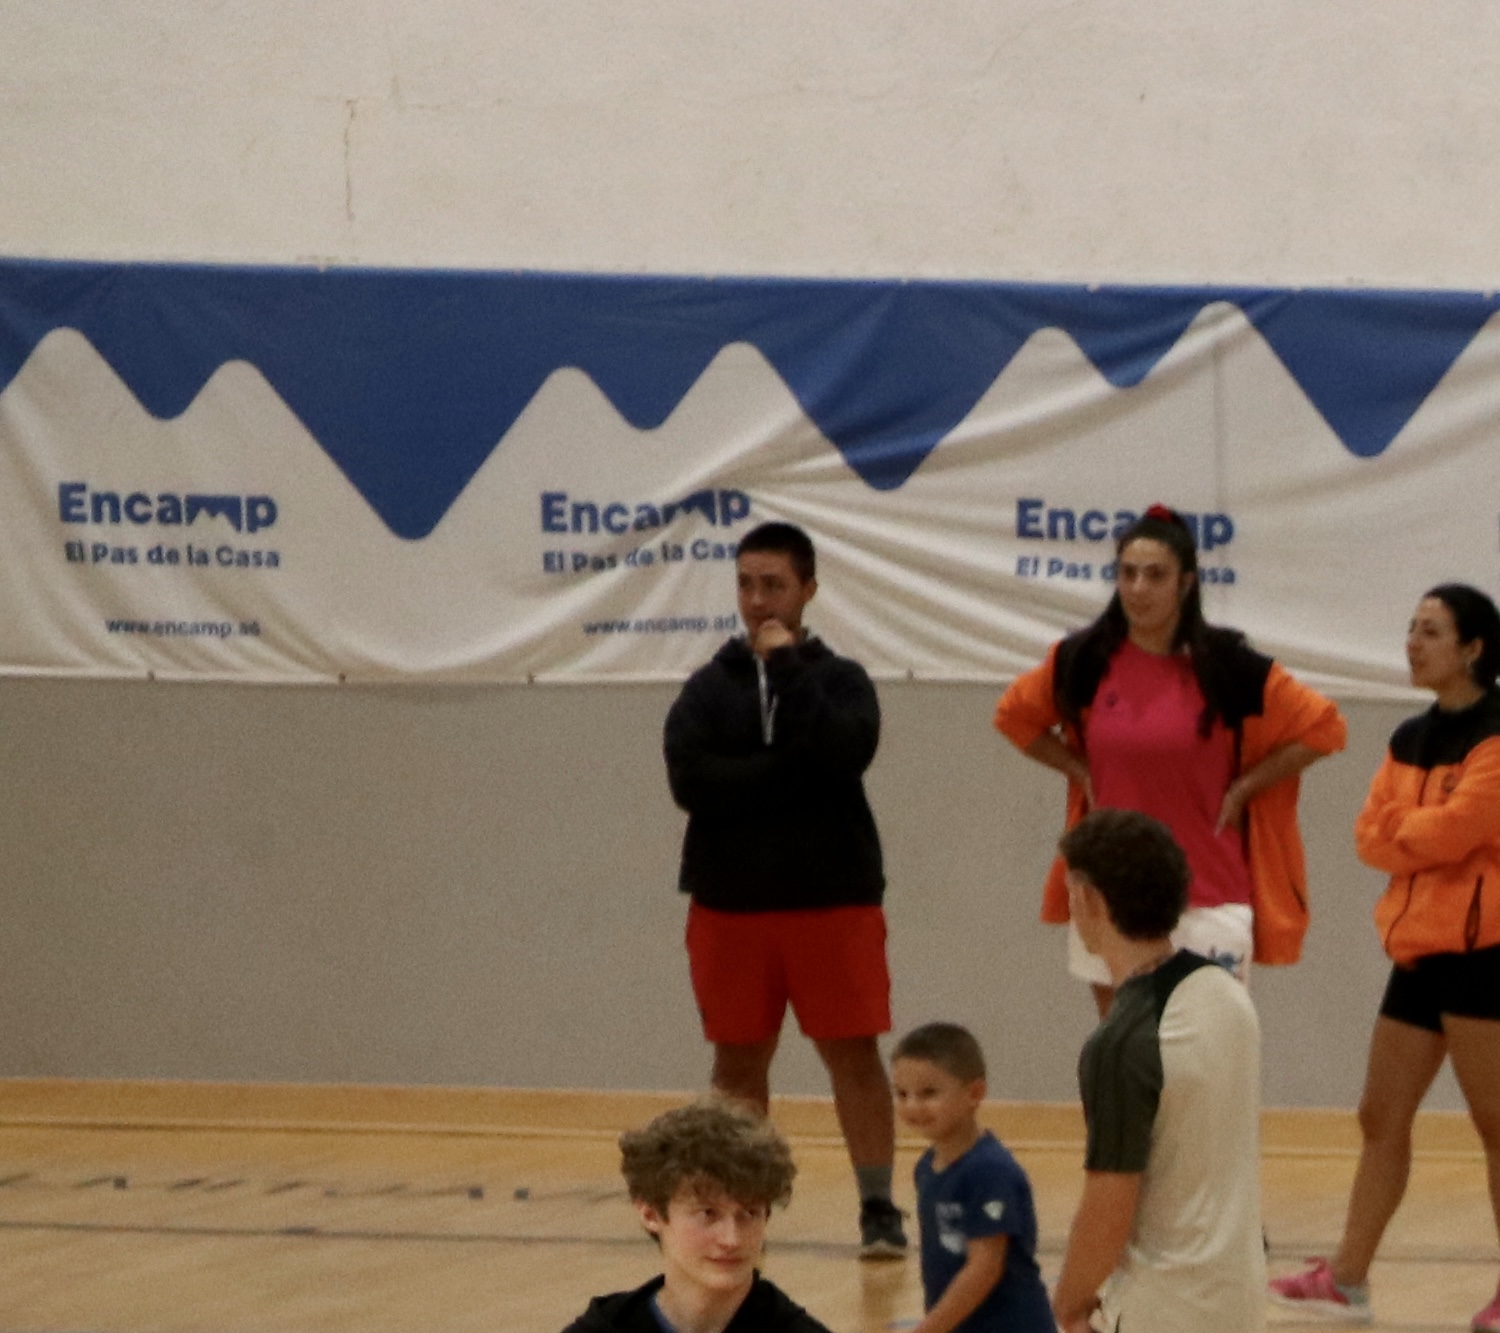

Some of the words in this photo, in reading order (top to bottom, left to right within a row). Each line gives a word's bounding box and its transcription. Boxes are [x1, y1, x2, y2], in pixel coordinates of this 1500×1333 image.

[59, 482, 278, 534] Encamp
[540, 488, 751, 536] Encamp
[64, 541, 86, 562] El
[91, 543, 139, 564] Pas
[146, 544, 181, 565] de
[186, 544, 211, 566] la
[214, 545, 281, 568] Casa
[543, 551, 565, 573] El
[570, 550, 619, 573] Pas
[624, 548, 656, 568] de
[663, 541, 685, 563] la
[690, 539, 738, 560] Cas
[1016, 556, 1041, 577] El
[1047, 557, 1093, 580] Pas
[1100, 561, 1118, 582] d
[1197, 566, 1237, 585] asa
